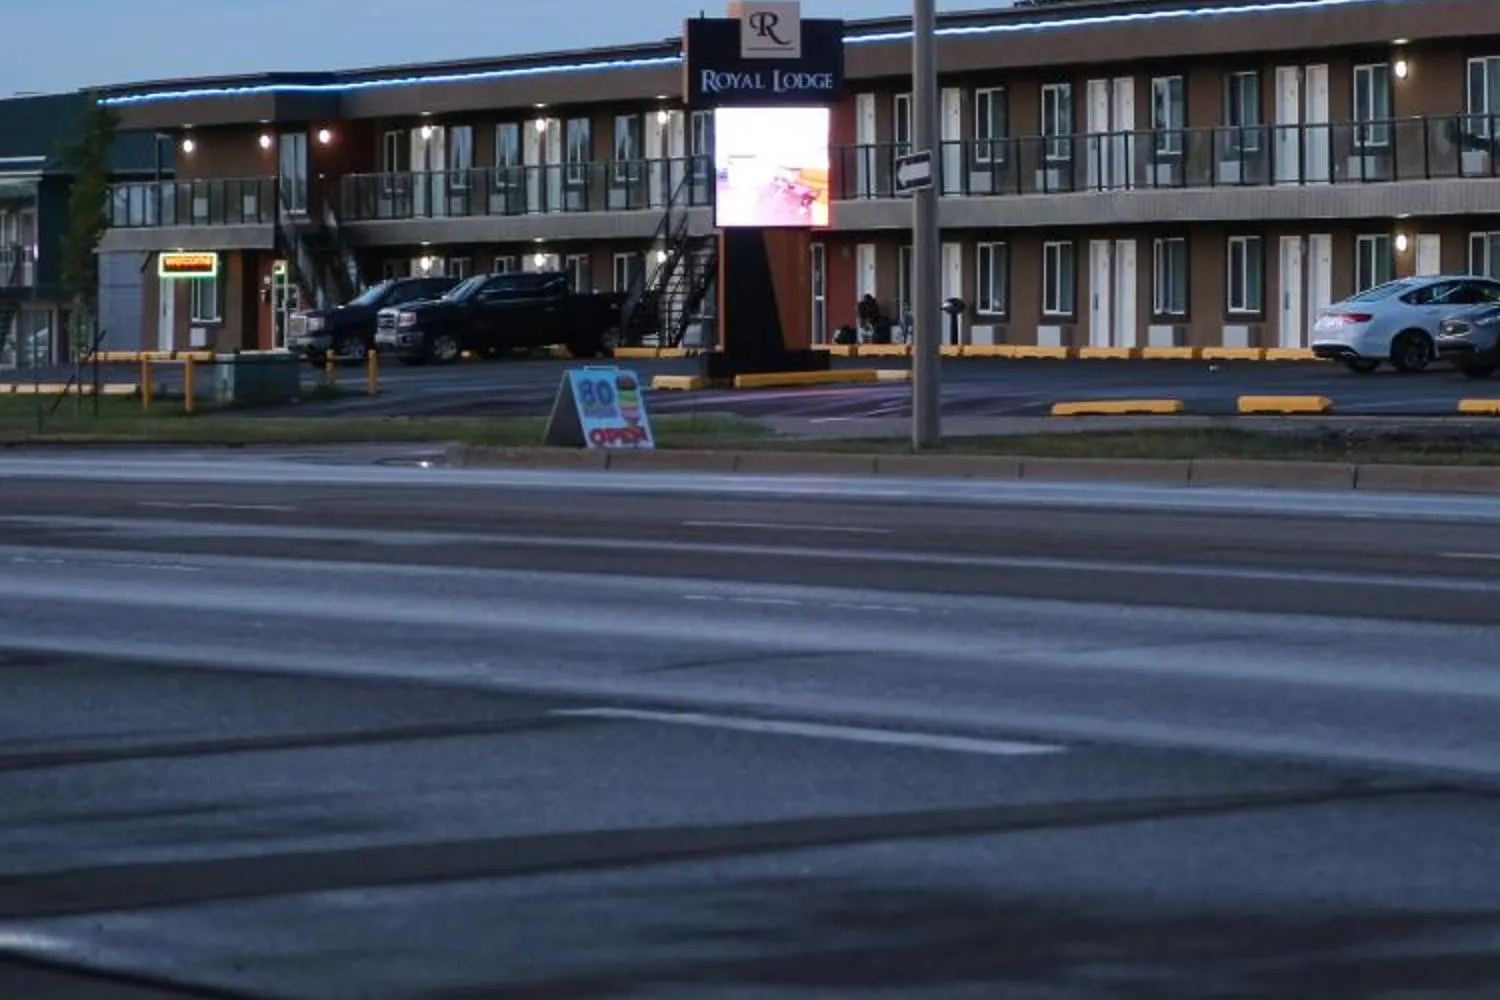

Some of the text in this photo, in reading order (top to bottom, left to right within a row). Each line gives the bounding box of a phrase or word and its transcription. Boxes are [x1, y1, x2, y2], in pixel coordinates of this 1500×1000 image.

[749, 10, 791, 45] R
[700, 69, 833, 92] ROYAL LODGE
